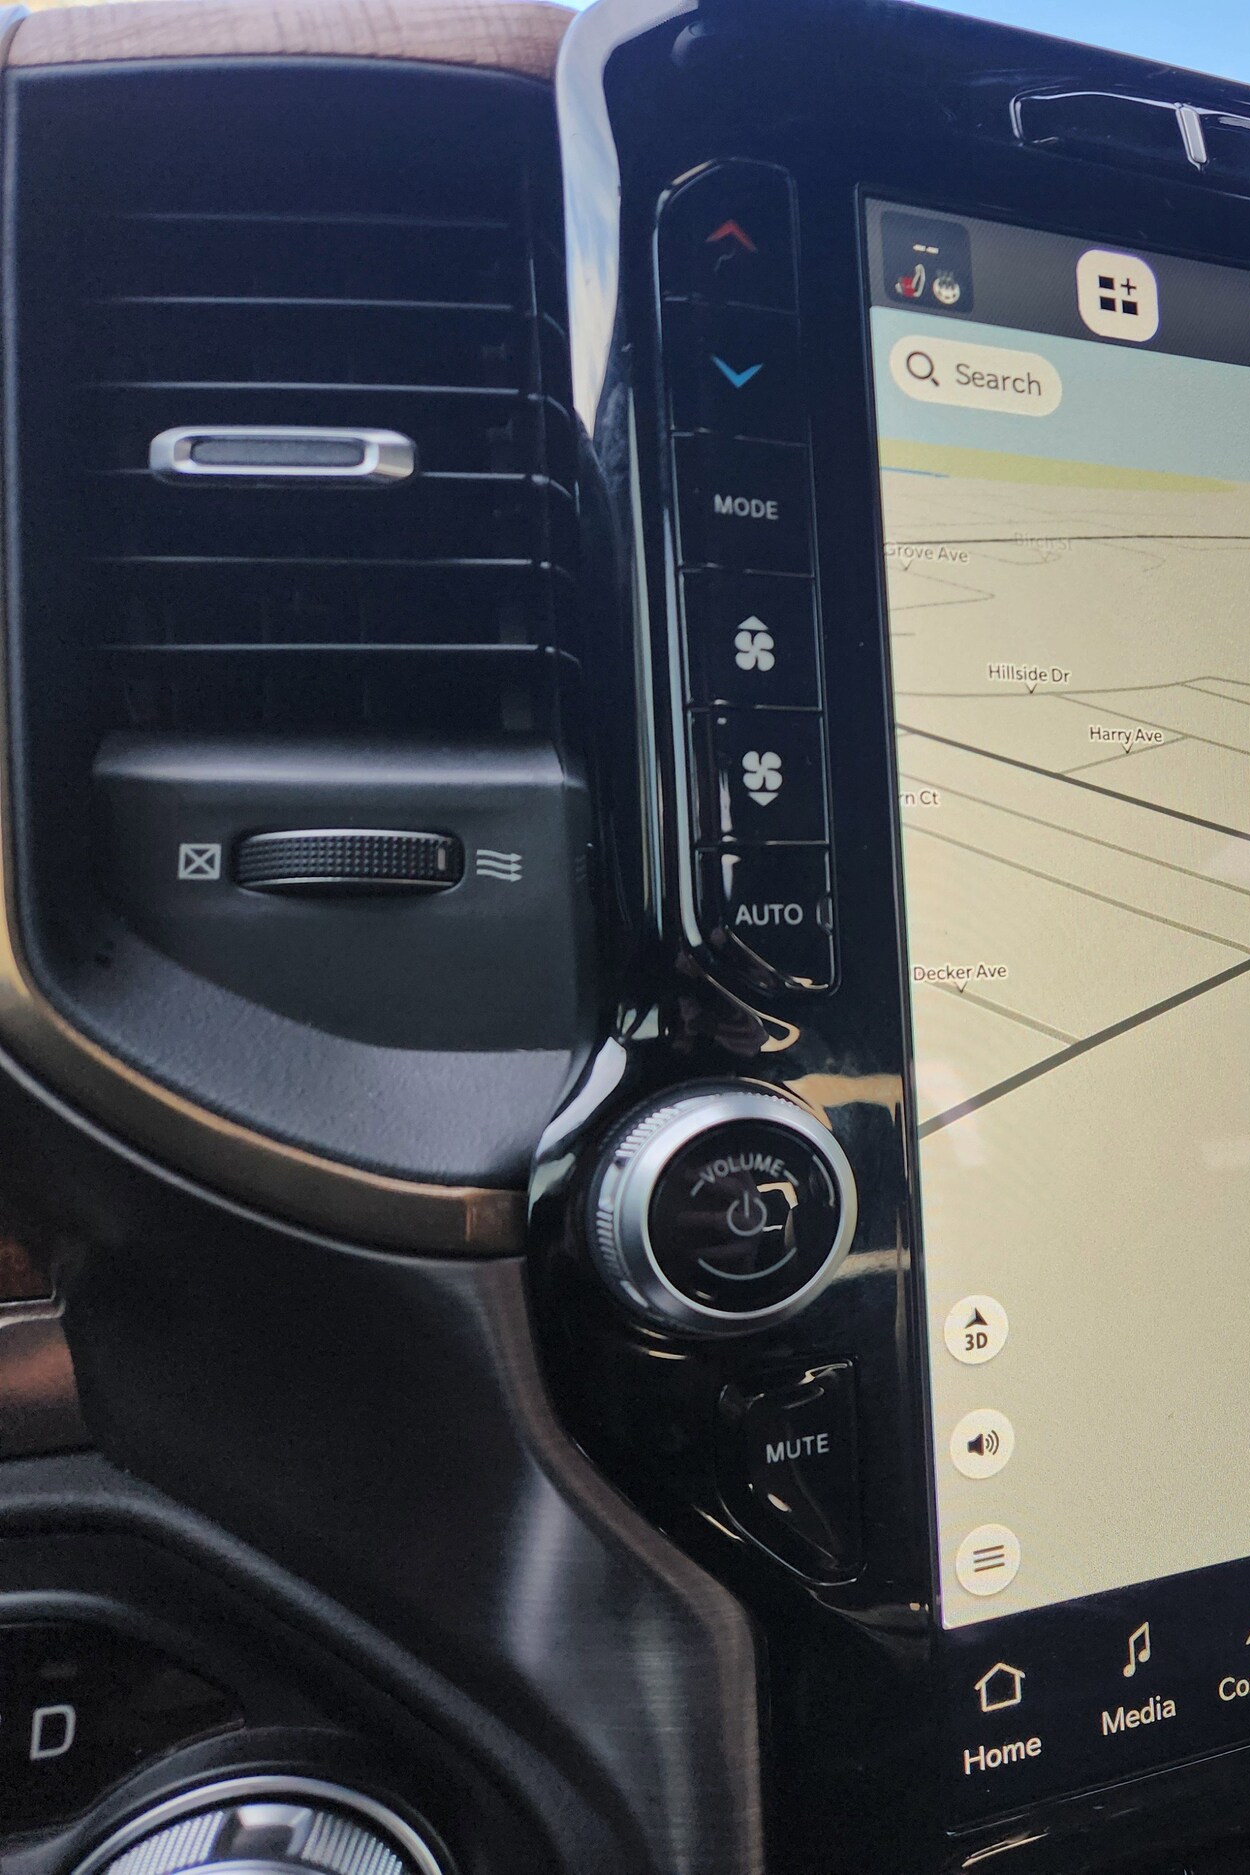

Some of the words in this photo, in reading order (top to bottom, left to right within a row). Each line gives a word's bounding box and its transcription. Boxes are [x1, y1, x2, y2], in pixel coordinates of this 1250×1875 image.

[954, 362, 1043, 398] Search
[713, 494, 779, 520] MODE
[937, 546, 969, 563] Ave
[988, 663, 1048, 683] Hillside
[1051, 667, 1070, 684] Dr
[1089, 726, 1131, 744] Harry
[1134, 728, 1162, 743] Ave
[919, 789, 940, 806] Ct
[735, 903, 804, 926] AUTO
[913, 963, 973, 982] Decker
[975, 963, 1008, 979] Ave
[699, 1152, 786, 1184] VOLUME
[964, 1332, 988, 1351] 3D
[766, 1432, 830, 1465] MUTE
[1101, 1695, 1177, 1736] Media
[30, 1704, 76, 1761] D
[963, 1736, 1043, 1776] Home
